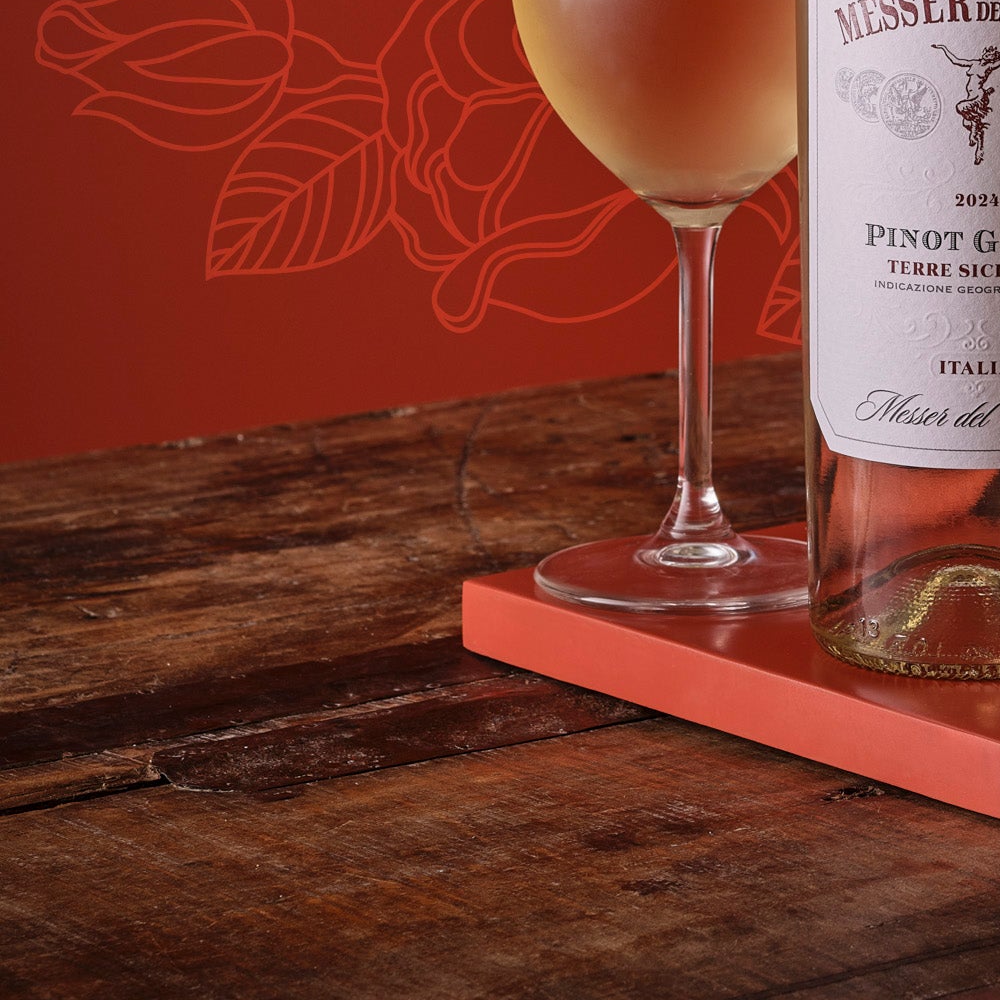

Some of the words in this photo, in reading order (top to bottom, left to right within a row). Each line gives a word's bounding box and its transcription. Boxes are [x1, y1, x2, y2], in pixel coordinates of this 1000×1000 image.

[955, 193, 1000, 208] 2024
[865, 223, 963, 251] PINOT
[887, 259, 952, 278] TERRE
[874, 280, 953, 294] INDICAZIONE
[855, 389, 950, 427] Messer
